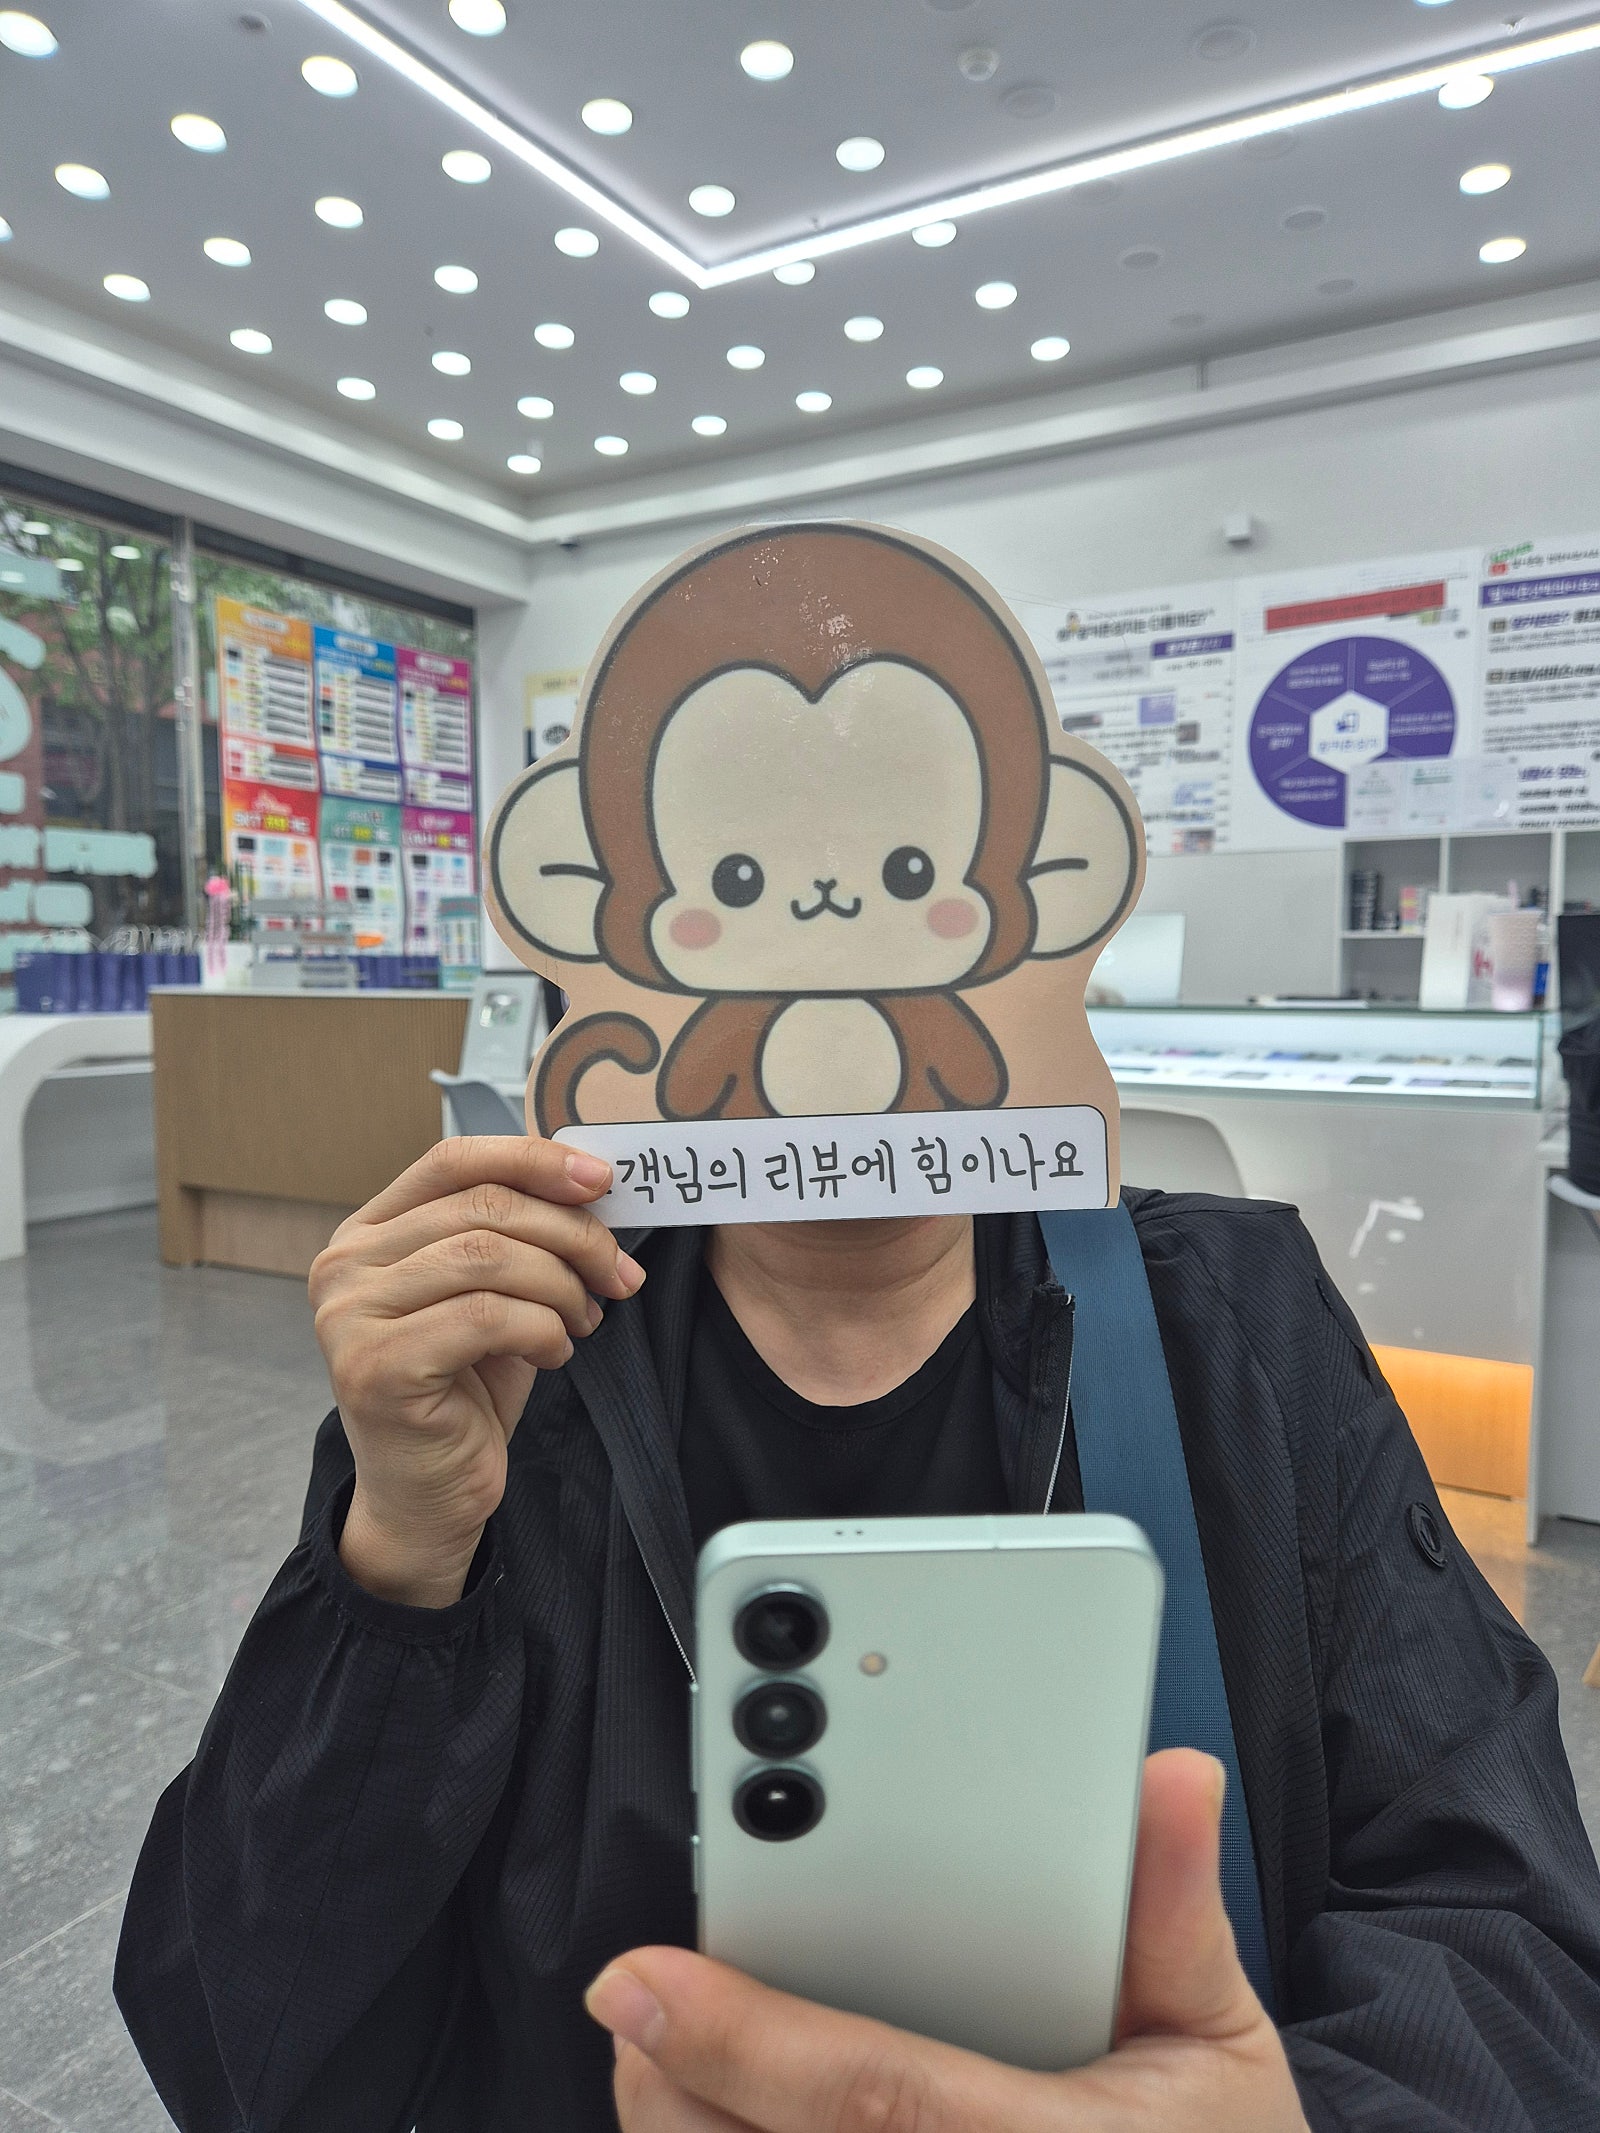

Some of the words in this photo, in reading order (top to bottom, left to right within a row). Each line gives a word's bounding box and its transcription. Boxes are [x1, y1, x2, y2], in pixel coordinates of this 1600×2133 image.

[600, 1147, 748, 1204] 객님의
[764, 1141, 897, 1201] 리뷰에
[910, 1132, 1085, 1195] 힘이나요
